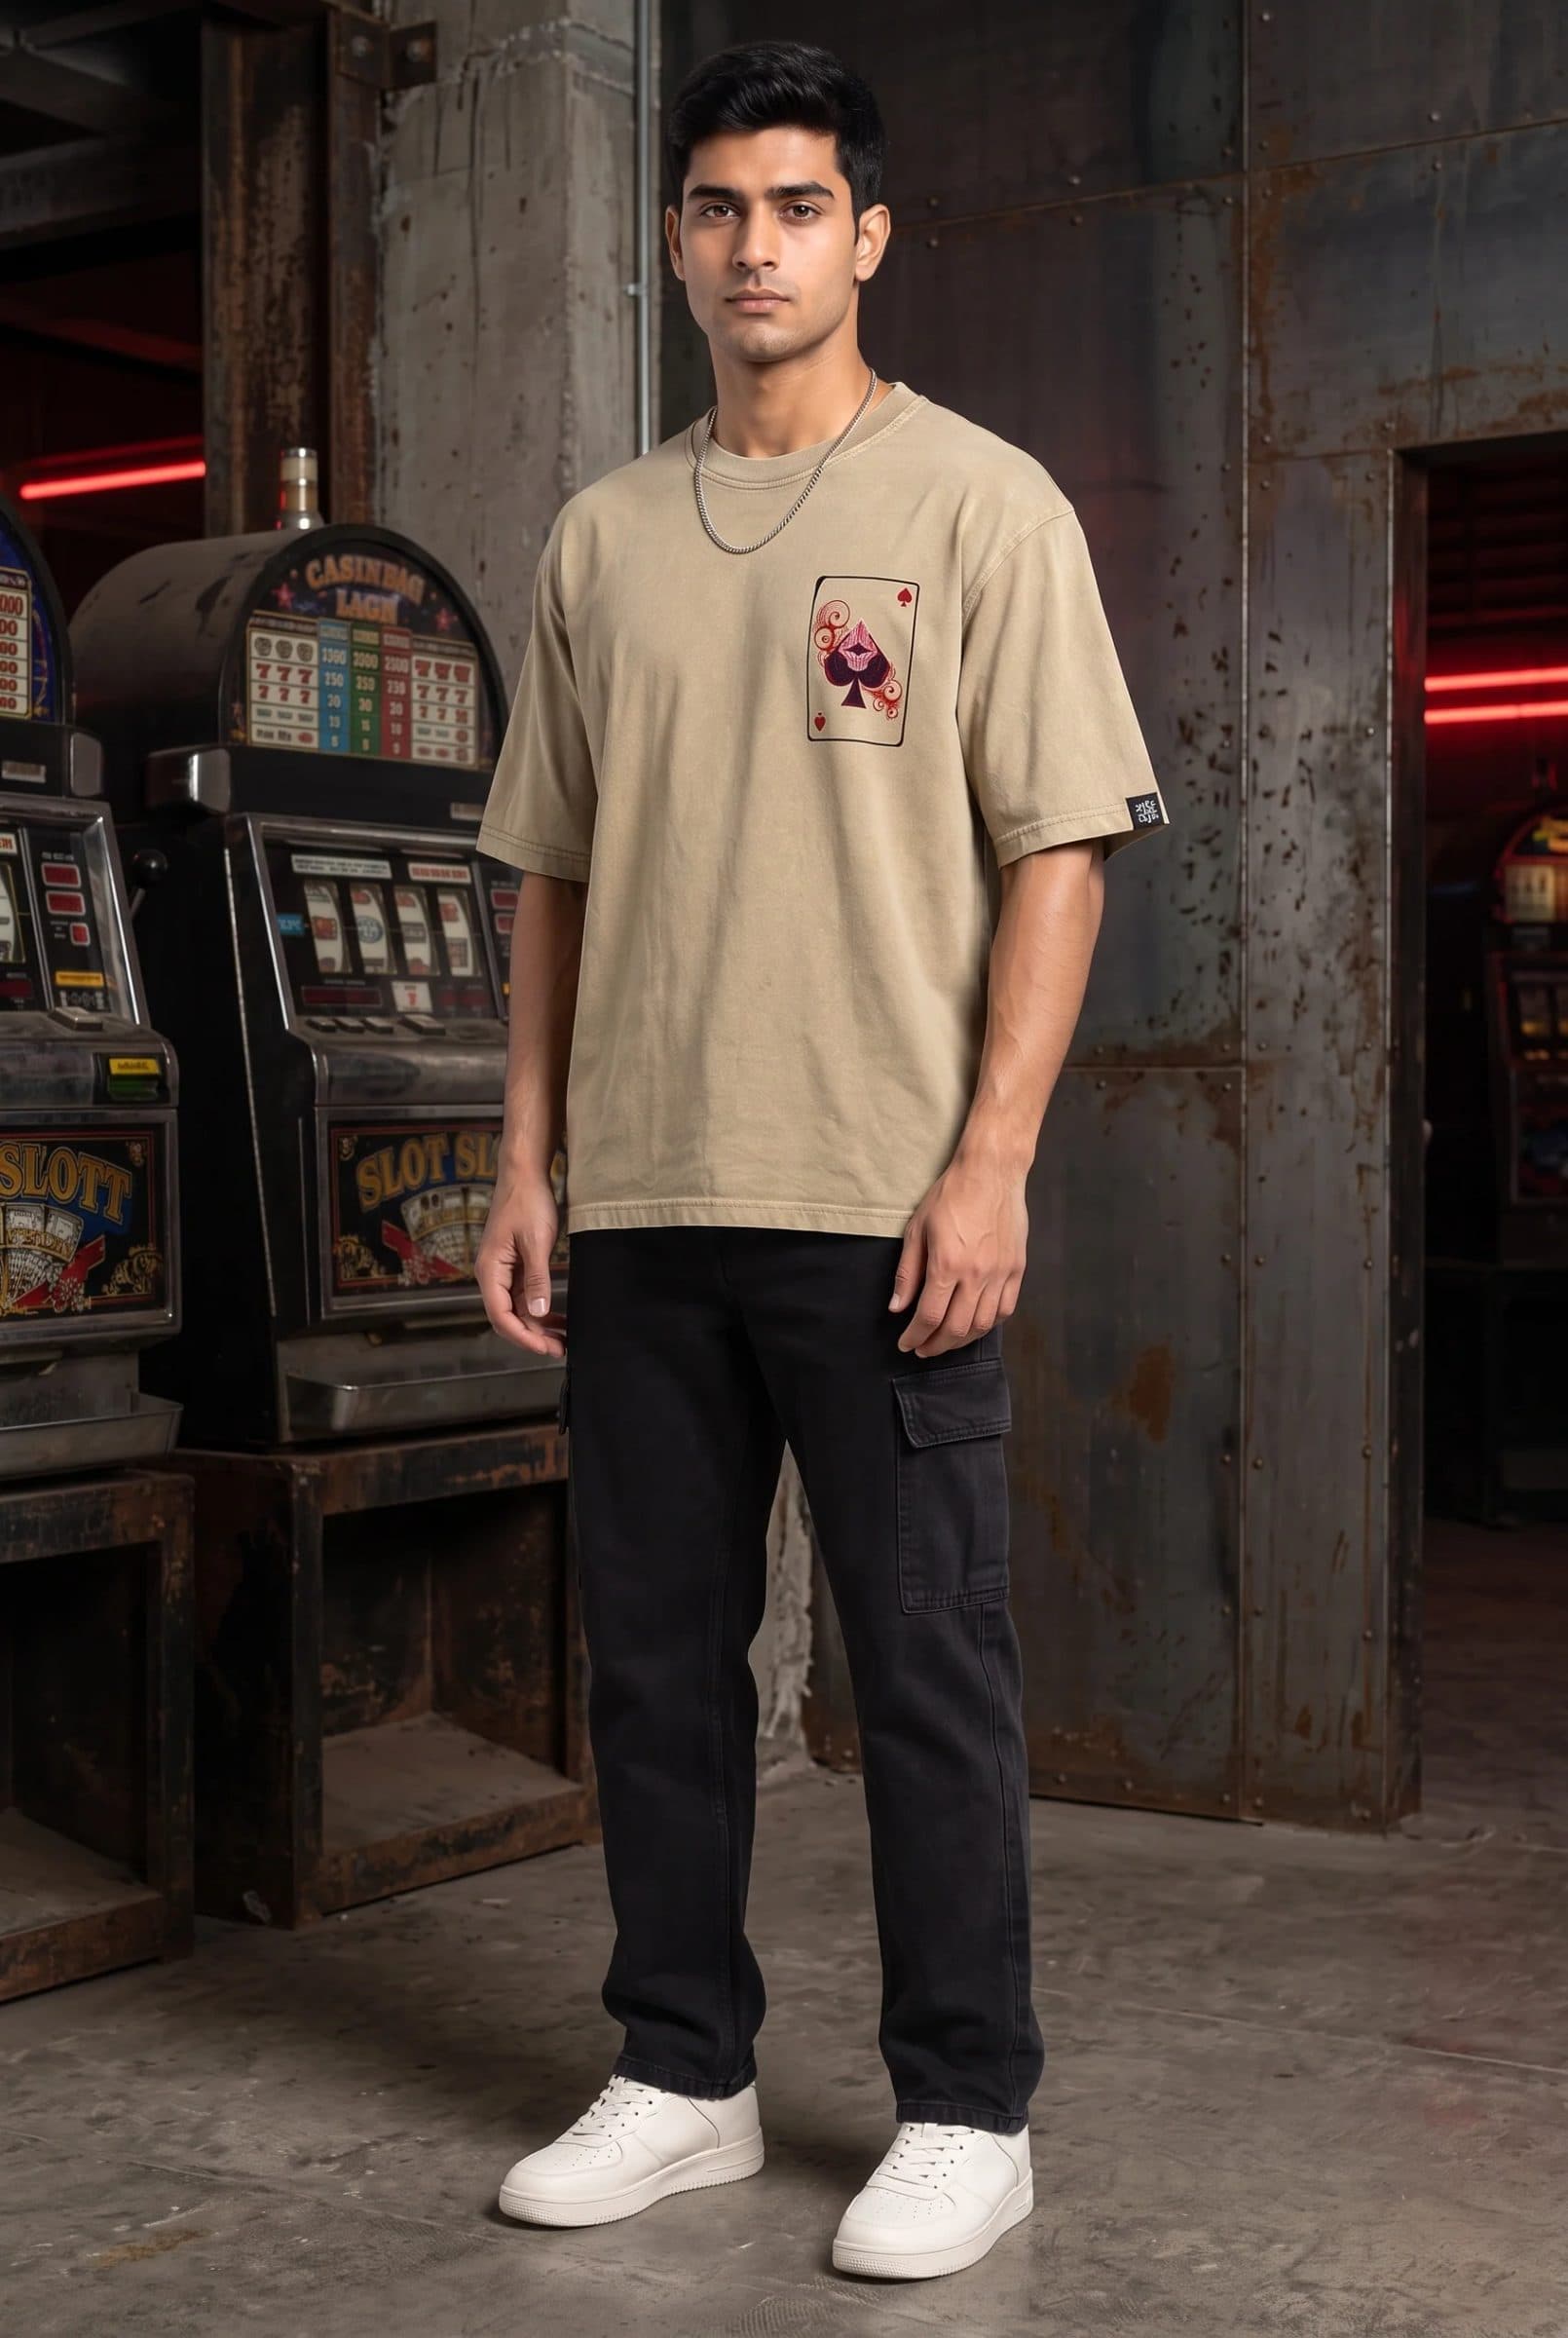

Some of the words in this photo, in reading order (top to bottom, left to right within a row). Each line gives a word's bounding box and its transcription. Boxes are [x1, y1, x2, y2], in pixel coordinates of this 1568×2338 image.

[0, 1142, 133, 1226] SLOTT
[355, 1133, 450, 1214] SLOT
[454, 1130, 504, 1180] SL
